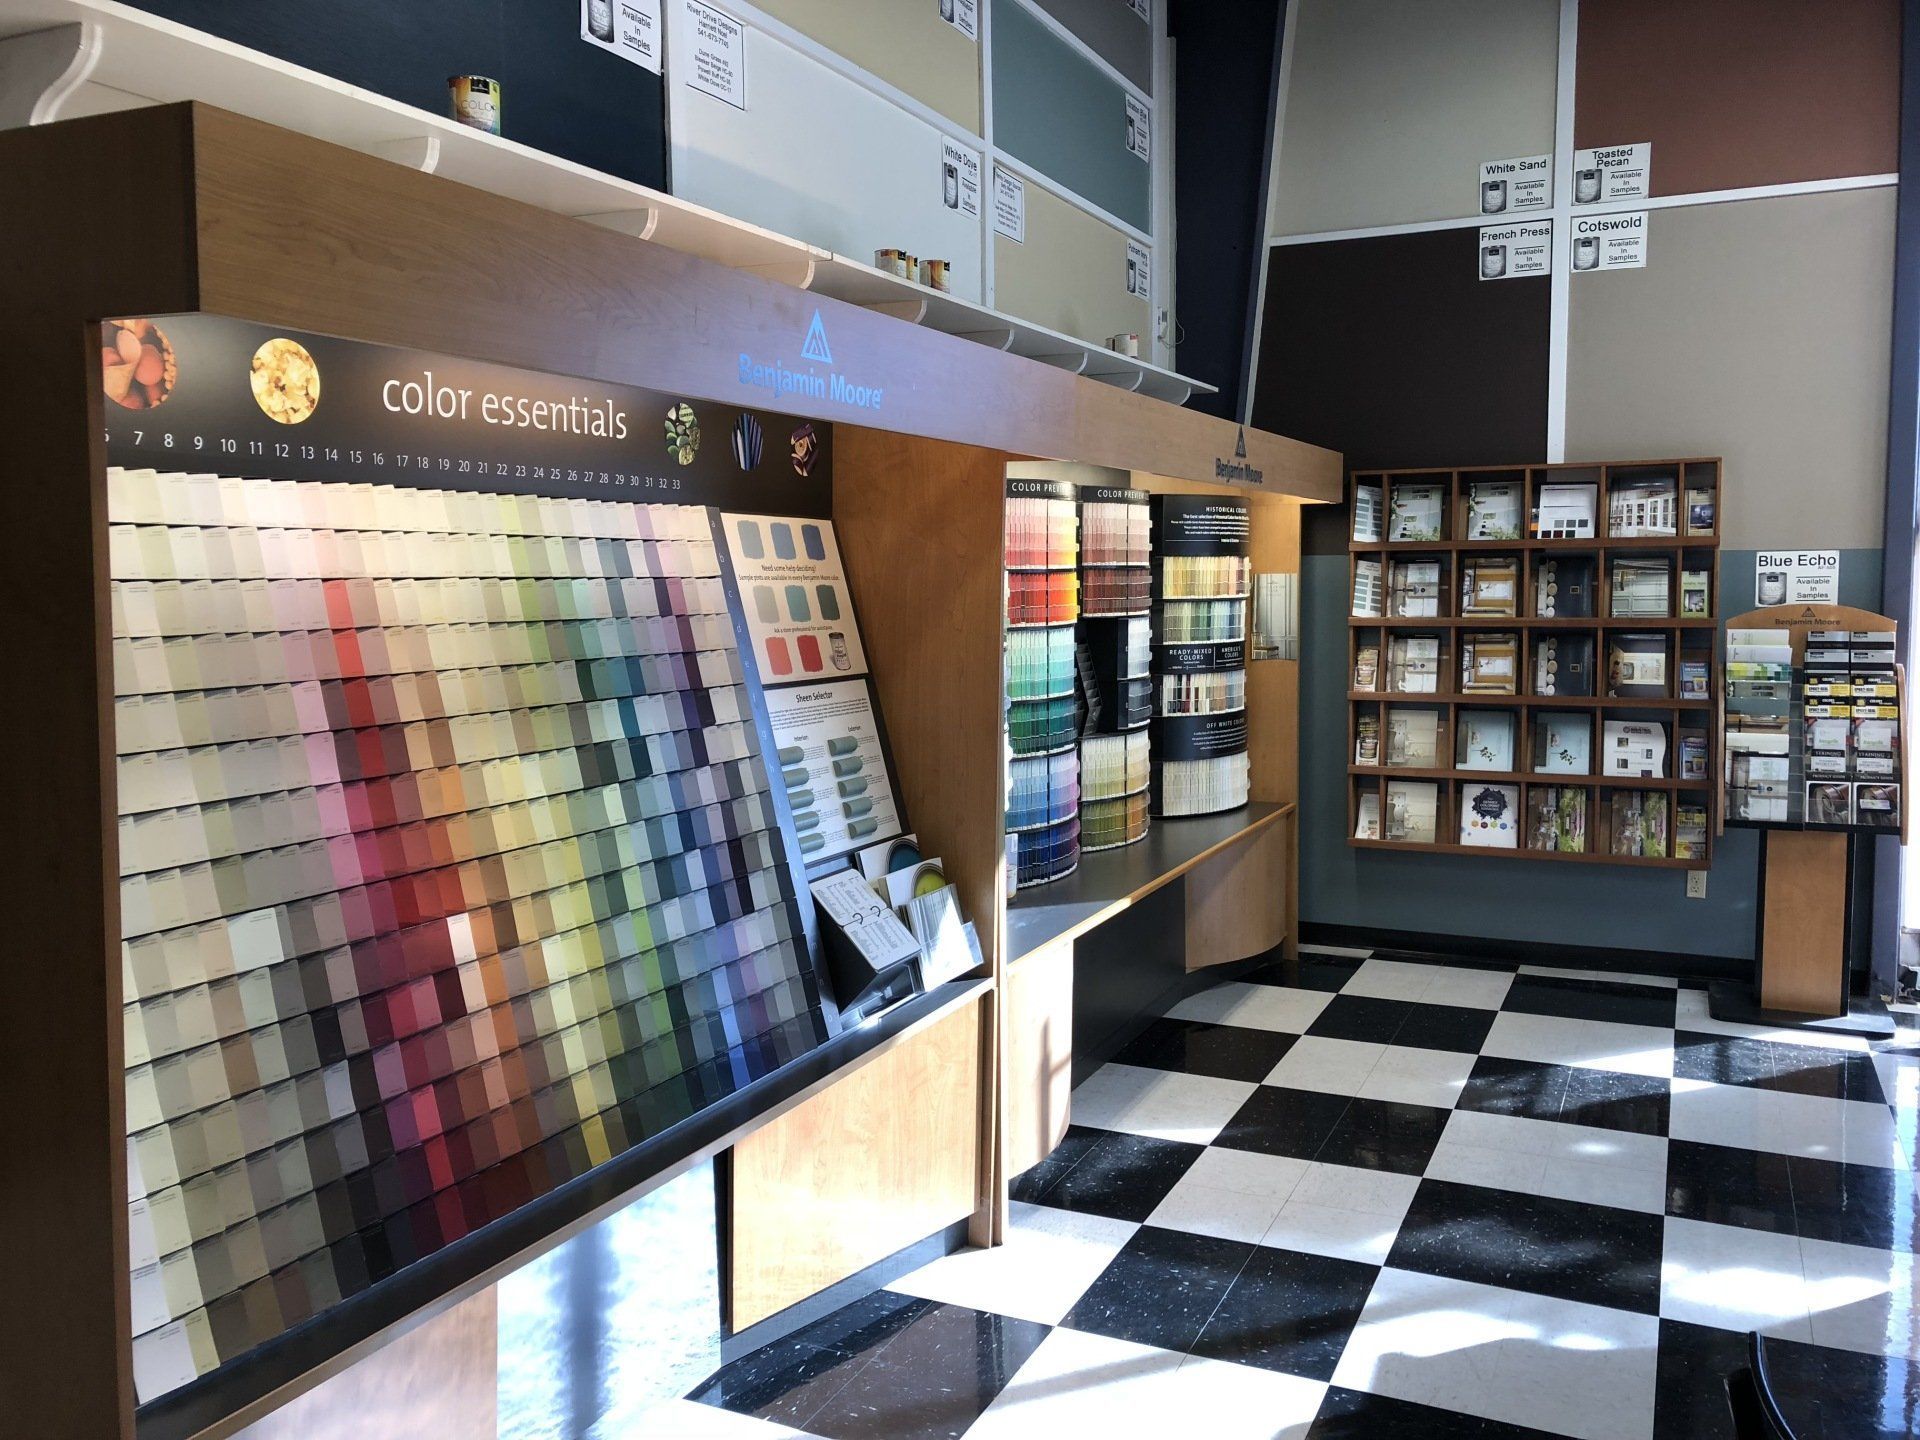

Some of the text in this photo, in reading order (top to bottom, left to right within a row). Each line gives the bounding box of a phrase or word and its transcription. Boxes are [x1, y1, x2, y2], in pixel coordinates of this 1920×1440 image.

[622, 8, 652, 29] Available
[687, 2, 738, 36] River Drive Designs
[634, 25, 641, 36] In
[623, 30, 651, 52] Samples
[697, 73, 710, 84] White
[944, 143, 978, 172] White Dove
[1592, 147, 1633, 160] Toasted
[1486, 159, 1547, 175] White Sand
[1596, 158, 1630, 168] Pecan
[1610, 171, 1642, 180] Available
[961, 179, 977, 194] Available
[1514, 182, 1545, 190] Available
[1610, 186, 1641, 195] Samples
[962, 197, 977, 211] Samples
[1515, 196, 1544, 204] Samples
[1578, 216, 1642, 233] Cotswold
[1481, 227, 1550, 242] French Press
[1608, 239, 1640, 248] Available
[1514, 248, 1544, 256] Available
[1608, 253, 1638, 262] Samples
[1514, 262, 1543, 270] Samples
[738, 353, 883, 410] Benjamin Moore
[383, 371, 627, 440] color essentials
[133, 431, 681, 490] 7 8 9 10 11 12 13 14 15 16 17 18 19 20 21 22 23 24 25 26 27 28 29 30 31 32 33
[1215, 457, 1244, 483] Benjamin
[1012, 482, 1041, 492] COLOR
[1097, 489, 1146, 499] COLOR PREVIEW
[1758, 554, 1837, 567] Blue Echo
[1796, 592, 1829, 600] Samples
[1775, 618, 1813, 626] Benjamin
[796, 691, 833, 703] Sheen Selector
